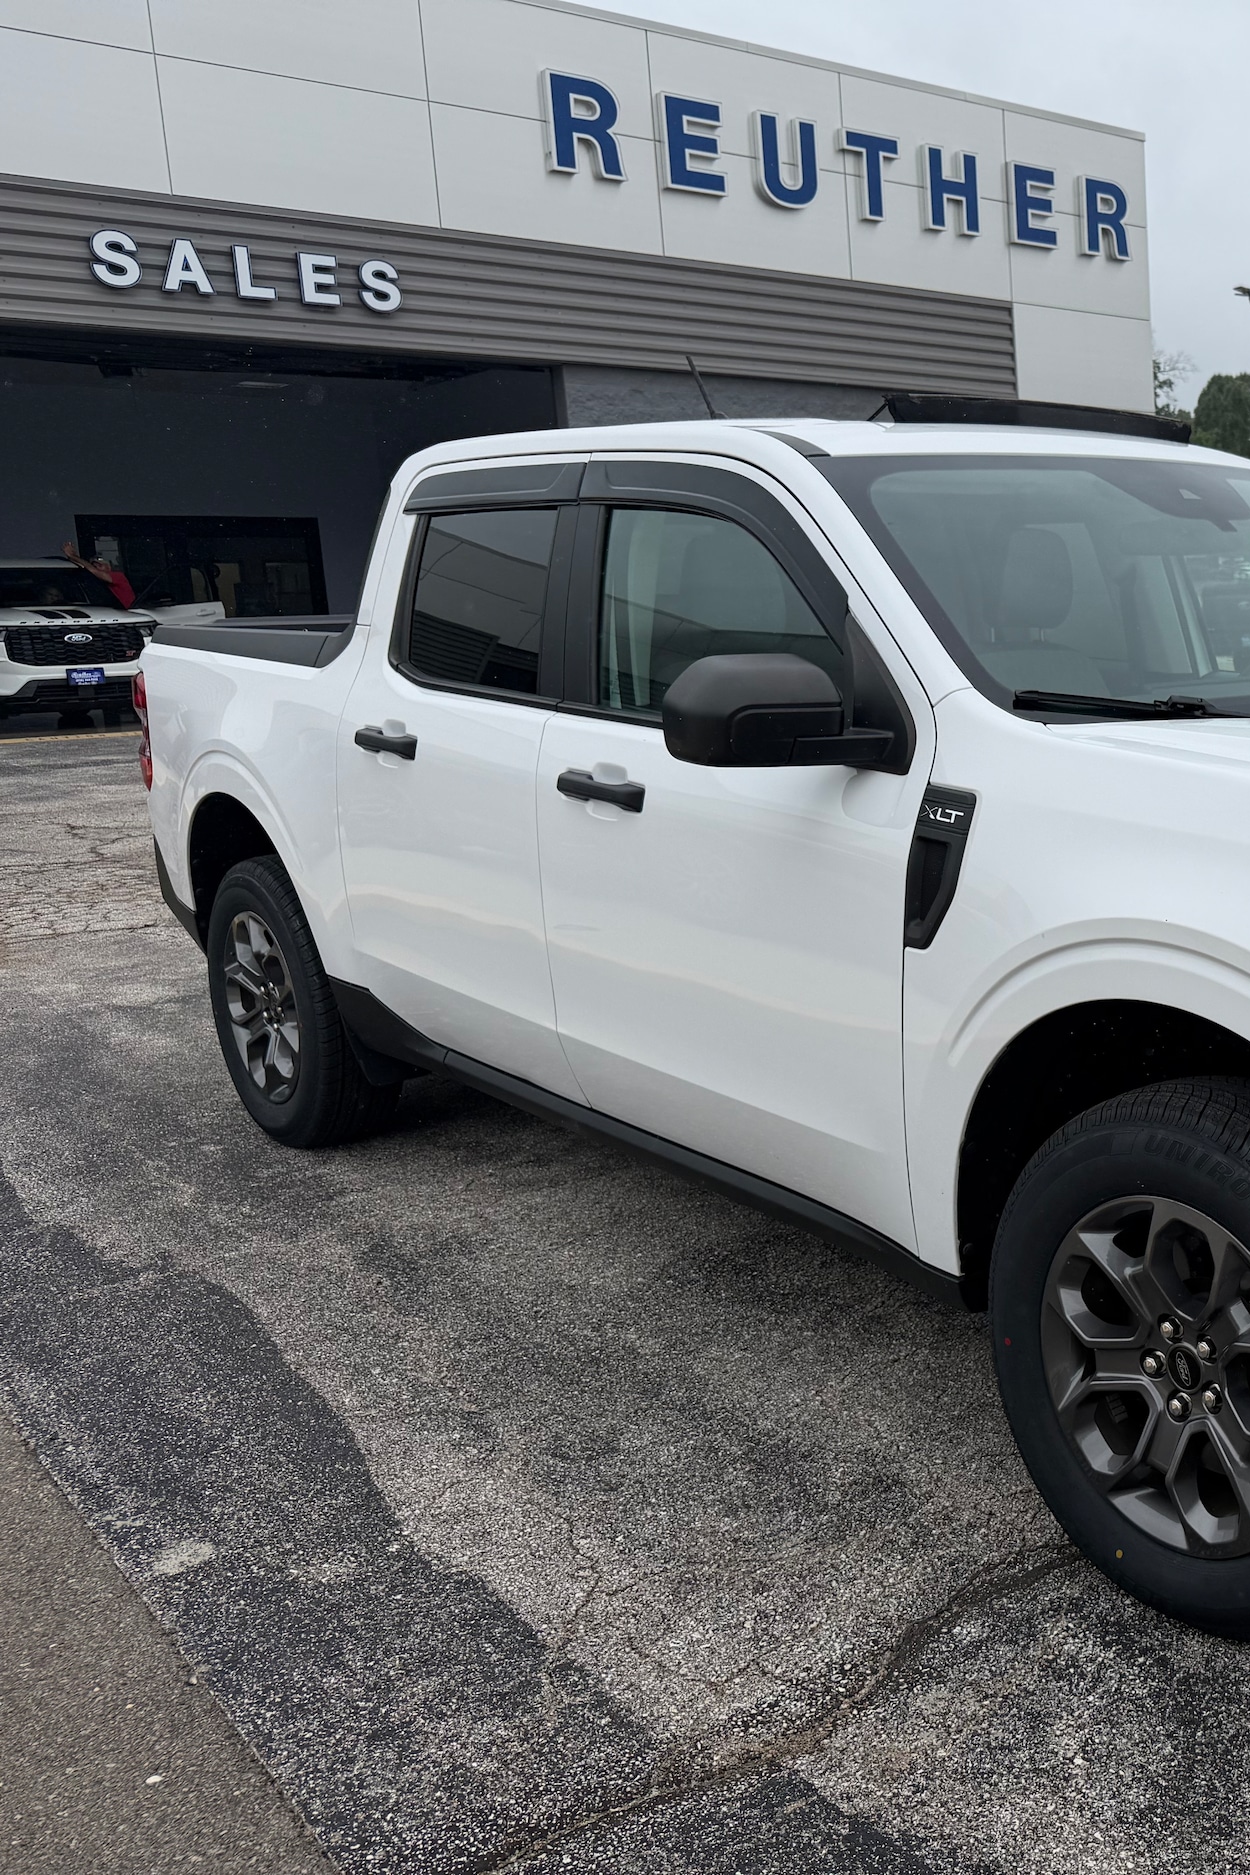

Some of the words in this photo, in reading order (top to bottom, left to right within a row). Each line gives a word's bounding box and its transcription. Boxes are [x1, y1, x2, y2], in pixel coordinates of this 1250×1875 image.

[540, 67, 1132, 262] REUTHER
[89, 228, 403, 313] SALES
[920, 804, 965, 824] XLT
